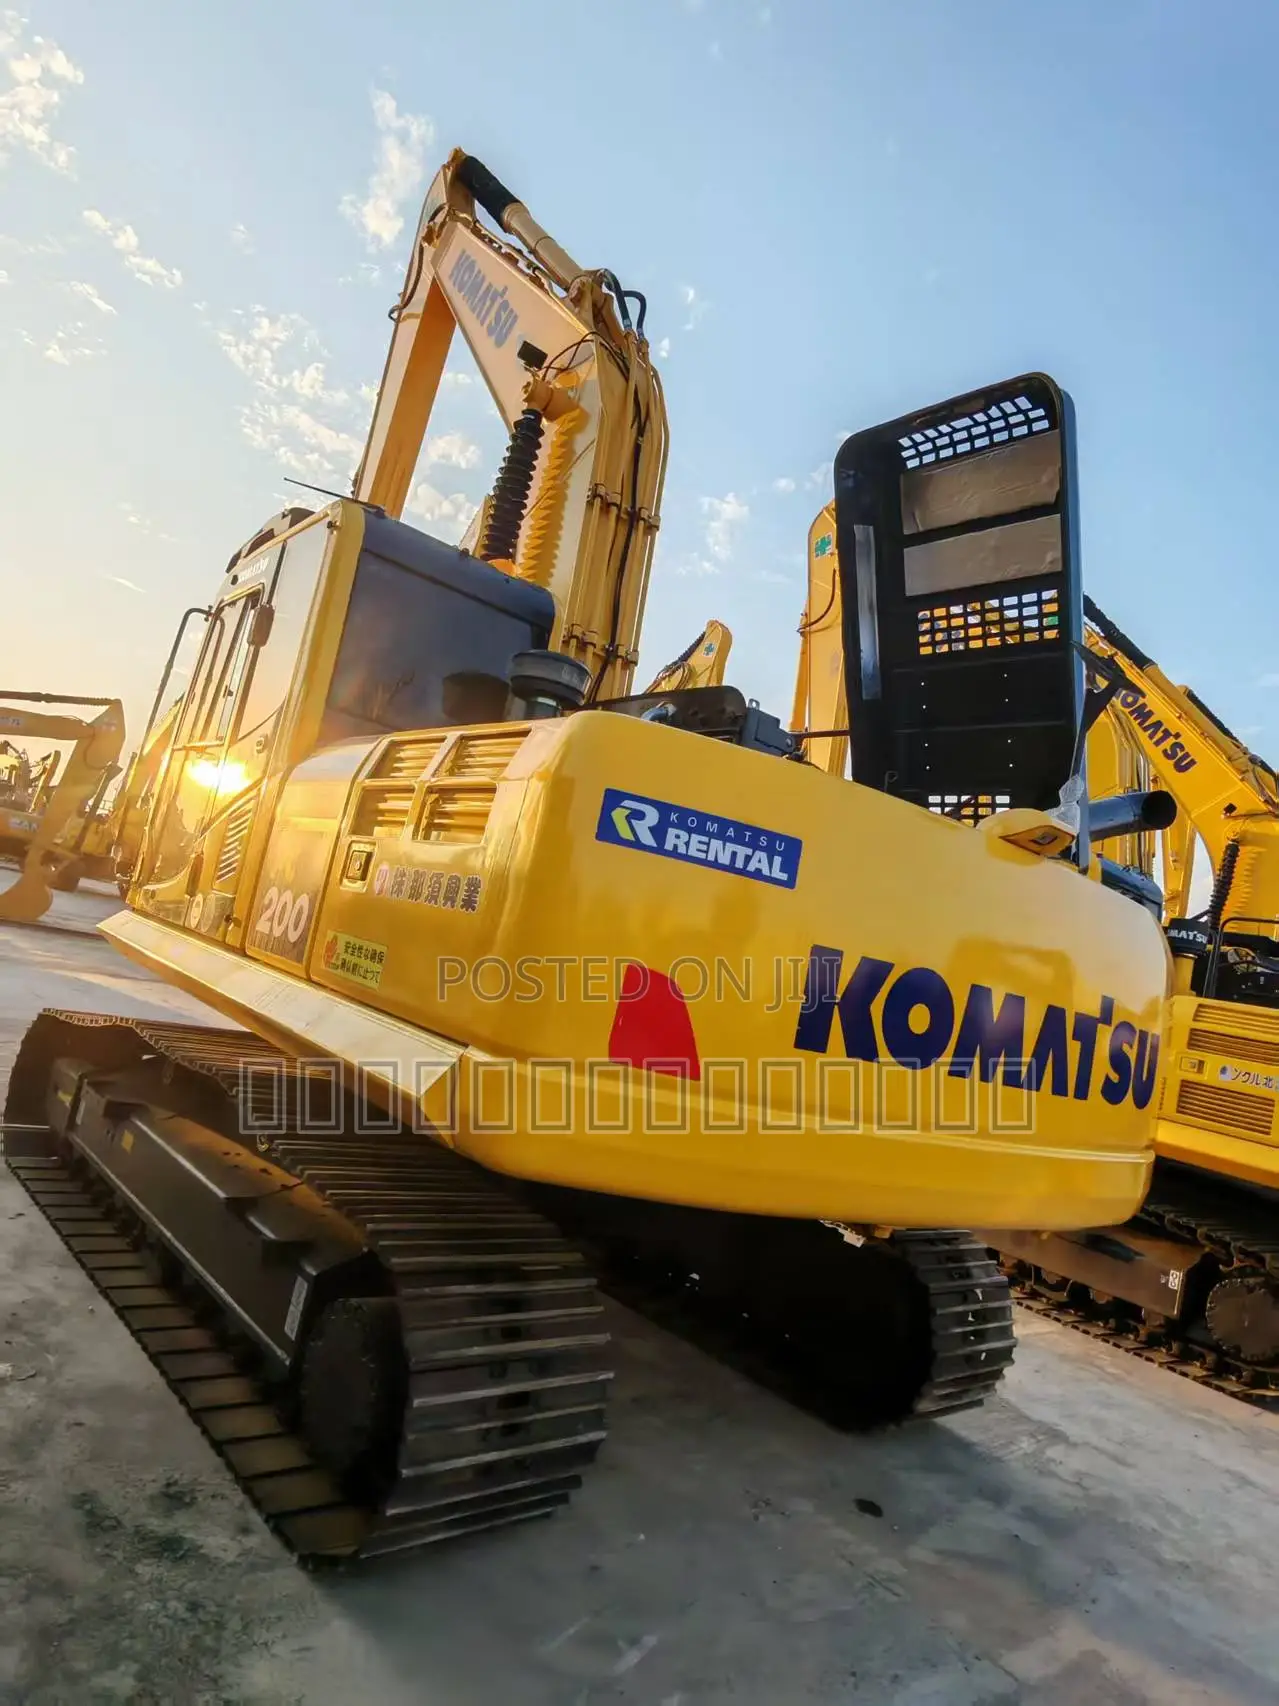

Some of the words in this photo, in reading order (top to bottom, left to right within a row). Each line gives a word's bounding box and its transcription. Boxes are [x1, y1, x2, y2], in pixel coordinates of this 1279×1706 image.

[449, 248, 518, 348] KOMATSU
[1114, 687, 1198, 773] OMATSU
[664, 827, 789, 881] RENTAL
[669, 811, 785, 851] KOMATSU
[255, 886, 310, 943] 200
[793, 943, 1160, 1109] KOMATSU
